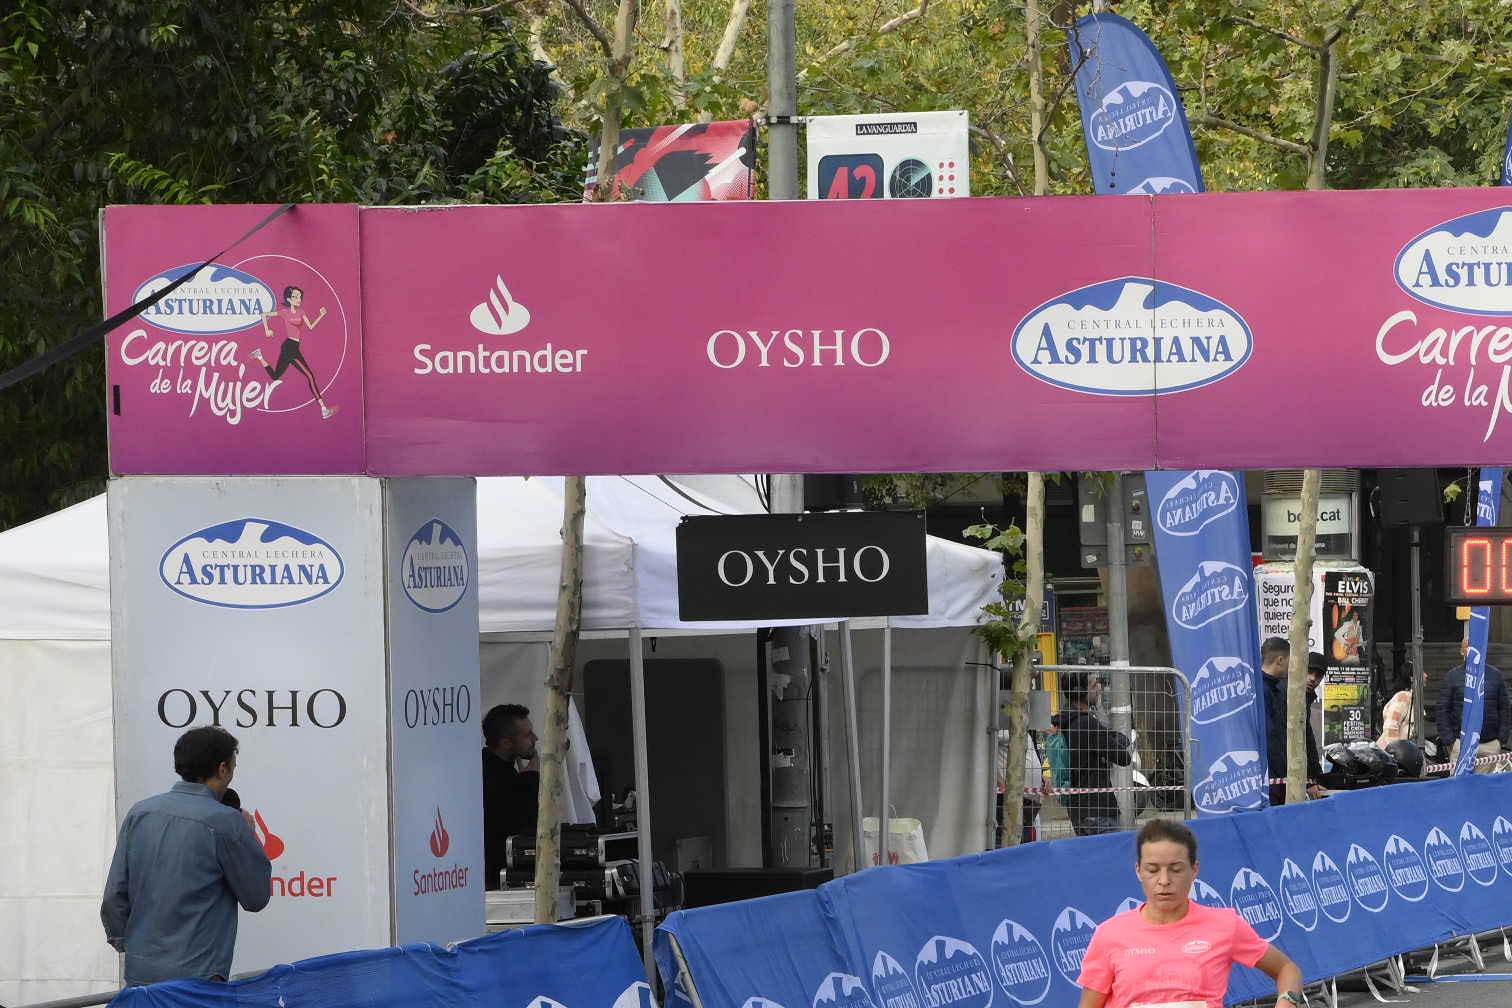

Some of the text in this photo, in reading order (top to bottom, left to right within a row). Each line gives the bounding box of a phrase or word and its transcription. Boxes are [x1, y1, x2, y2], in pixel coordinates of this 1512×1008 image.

[175, 287, 212, 295] ENTRAL
[1067, 317, 1226, 331] CENTRAL LECHERA
[120, 330, 239, 366] Carrera
[414, 343, 588, 375] Santander
[707, 328, 890, 369] OYSHO
[1030, 322, 1234, 366] ASTURIANA
[150, 364, 283, 425] de la Mujer
[1421, 369, 1455, 407] de
[1464, 368, 1489, 407] la
[174, 552, 331, 586] ASTURIANA
[202, 549, 325, 559] CENTRAL LECHERA
[717, 545, 890, 587] OYSHO
[406, 553, 466, 590] ASTURIANA
[1338, 581, 1369, 593] ELVIS
[1264, 598, 1280, 609] que
[1264, 610, 1296, 621] quiere
[157, 688, 347, 728] OYSHO
[404, 684, 470, 729] OYSHO
[1349, 710, 1361, 720] 30
[413, 865, 469, 896] Santander
[997, 955, 1049, 987] ASTURIANA
[921, 970, 991, 1008] ASTURIANA
